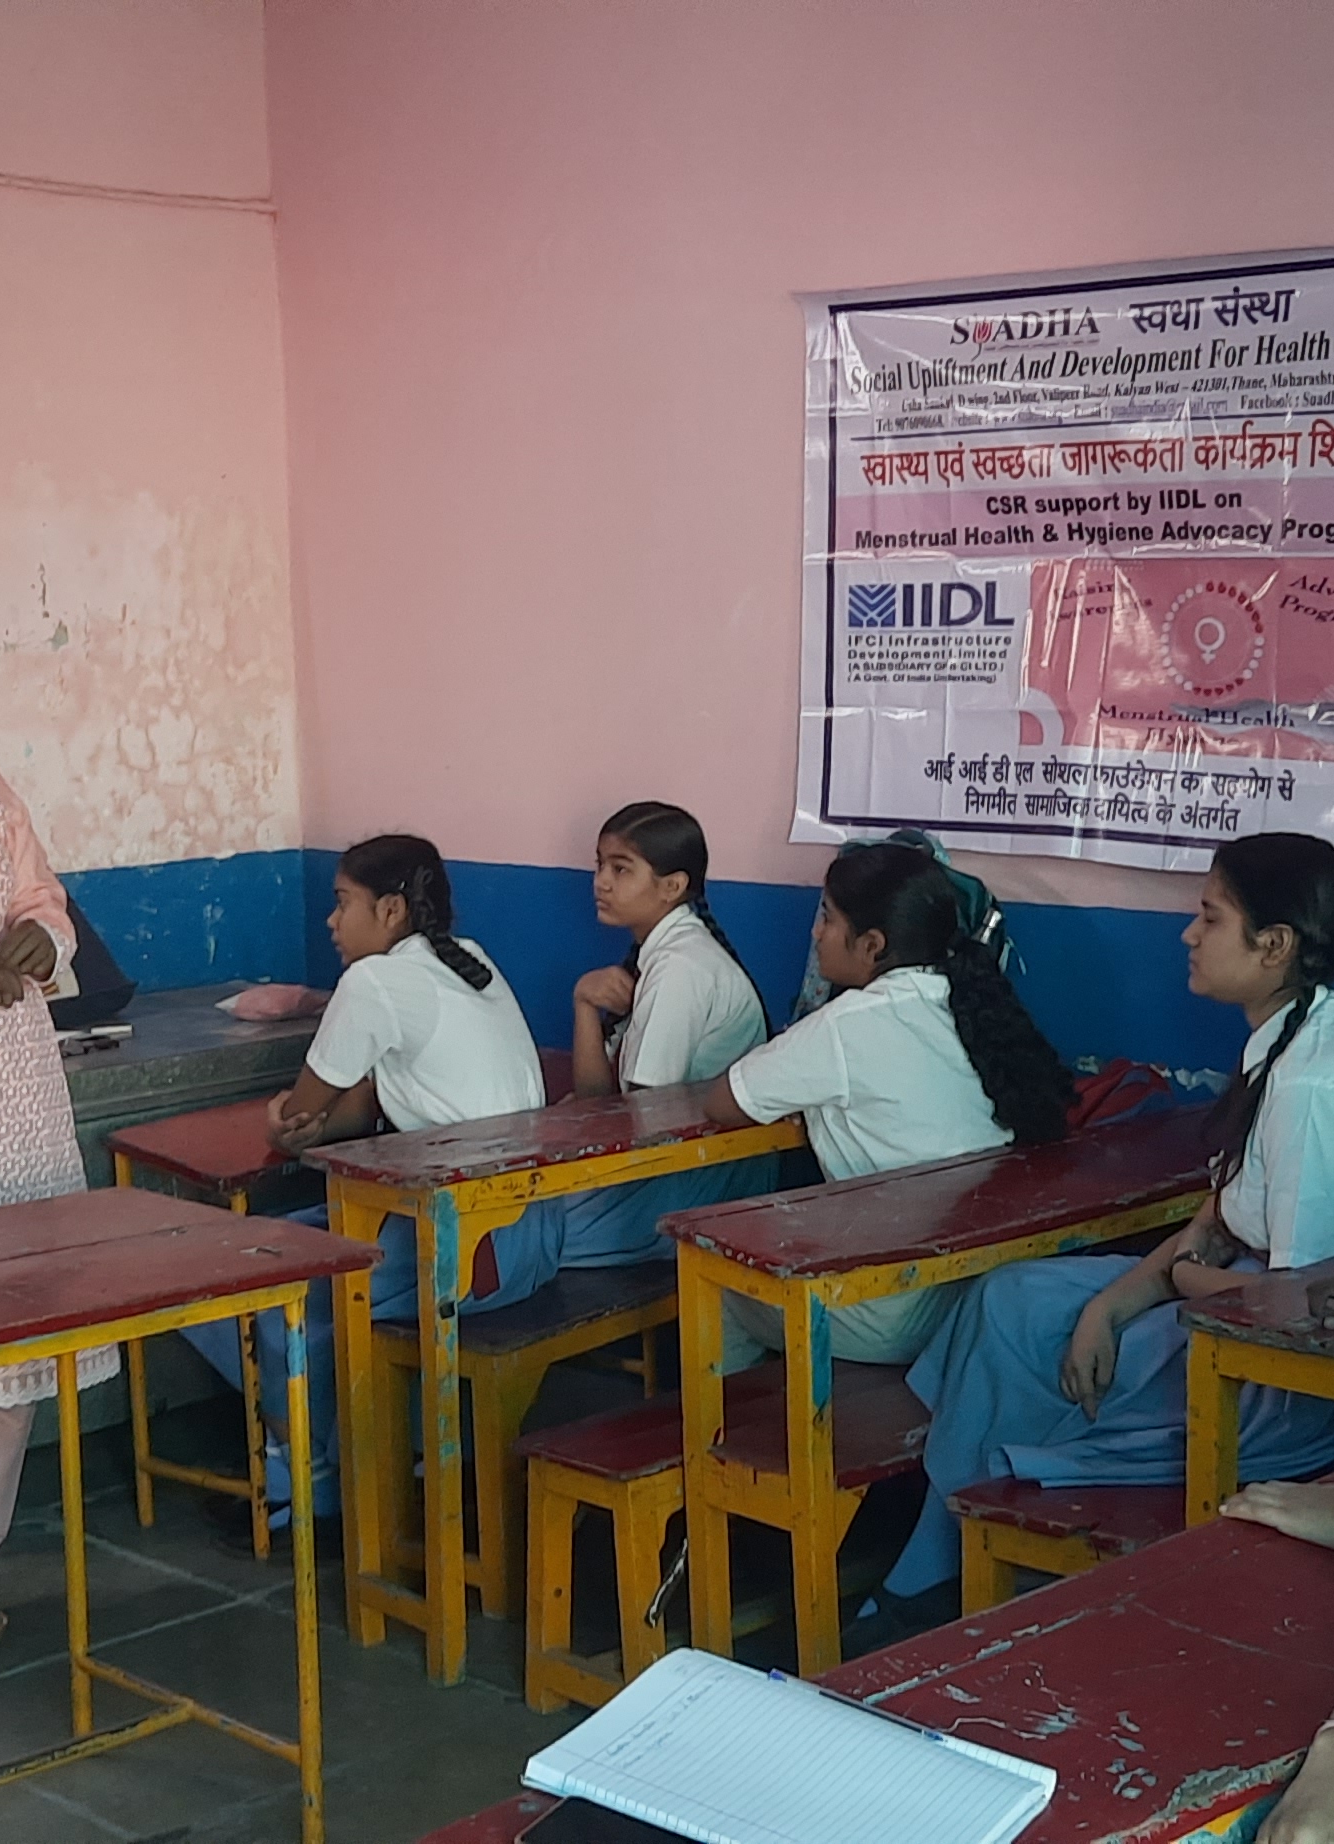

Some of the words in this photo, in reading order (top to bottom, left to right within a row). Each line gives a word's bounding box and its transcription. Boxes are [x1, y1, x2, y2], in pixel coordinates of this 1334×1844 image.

[1129, 298, 1204, 335] स्वधा
[1212, 286, 1295, 327] संस्था
[850, 362, 902, 396] Social
[908, 357, 1007, 396] Upliftment
[1011, 351, 1057, 382] And
[1059, 340, 1201, 382] Development
[1209, 337, 1249, 369] For
[1254, 330, 1330, 366] Health
[860, 452, 929, 486] स्वास्थ्य
[934, 441, 965, 488] एवं
[970, 444, 1055, 481] स्वच्छता
[1060, 437, 1185, 477] जागरूकता
[1192, 420, 1302, 471] कार्यक्रम
[987, 495, 1029, 516] CSR
[1035, 492, 1120, 517] support
[1127, 490, 1152, 515] by
[1159, 489, 1206, 510] IIDL
[1214, 491, 1243, 509] on
[855, 527, 957, 549] Menstrual
[964, 525, 1035, 545] Health
[1043, 523, 1059, 543] &
[1068, 520, 1153, 546] Hygiene
[1161, 519, 1274, 544] Advocacy
[902, 580, 1015, 627] IIDL
[848, 635, 883, 647] IFCI
[888, 634, 1012, 647] Infrastructure
[924, 752, 955, 785] आई
[958, 752, 988, 785] आई
[991, 754, 1010, 784] डी
[1014, 761, 1035, 786] एल
[1041, 754, 1091, 786] सोशल
[1277, 769, 1296, 802] से
[1024, 787, 1091, 818] सामाजिक
[1156, 794, 1177, 826] के
